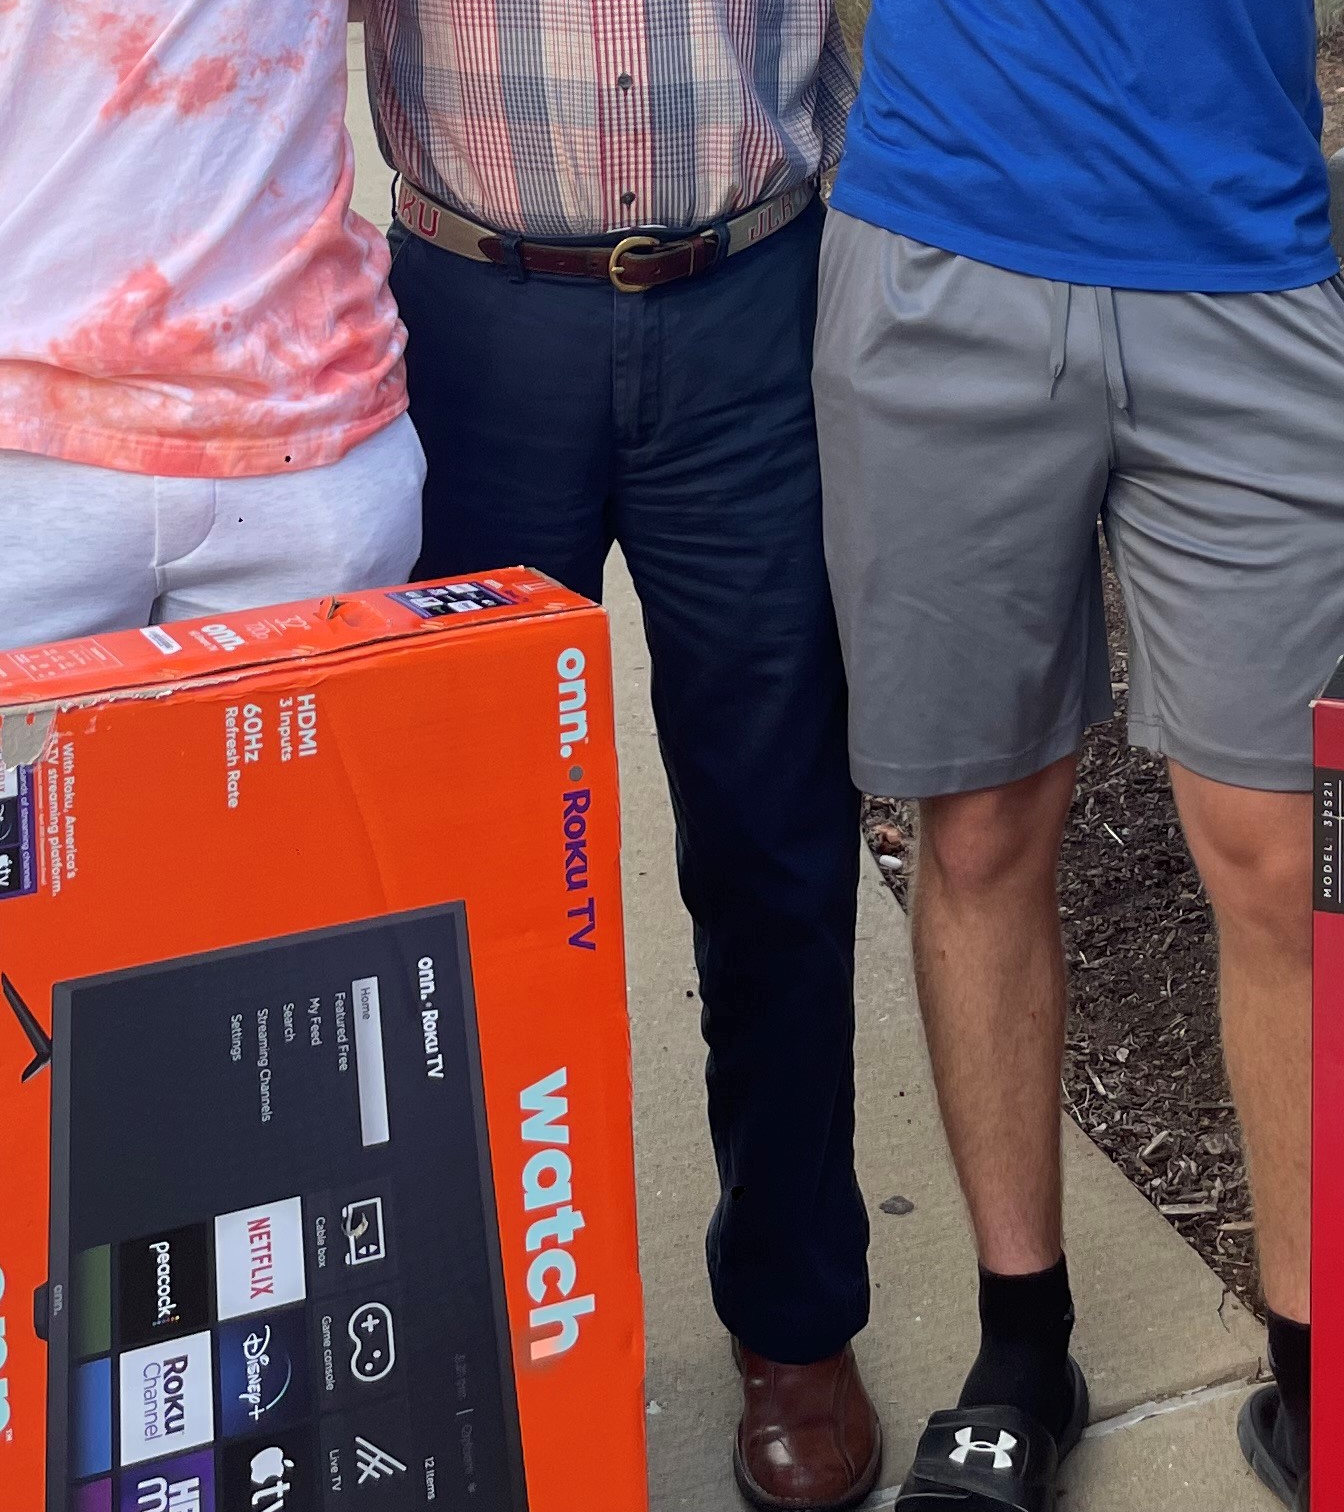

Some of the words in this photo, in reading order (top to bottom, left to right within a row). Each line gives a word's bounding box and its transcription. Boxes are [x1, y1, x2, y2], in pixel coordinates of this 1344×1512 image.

[278, 697, 292, 708] 3
[556, 646, 588, 759] onn.
[224, 706, 239, 767] Refresh
[242, 702, 264, 764] 60Hz
[279, 711, 293, 762] Inputs
[297, 693, 318, 758] HDMI
[47, 746, 60, 765] TV
[62, 742, 75, 776] With
[46, 770, 59, 834] streaming
[63, 777, 76, 814] Roku,
[227, 769, 241, 809] Rate
[1322, 782, 1333, 828] 32S21
[21, 808, 31, 852] streaming
[64, 816, 77, 880] America's
[22, 852, 32, 890] channels
[47, 838, 61, 896] platform.
[567, 897, 597, 952] TV
[282, 1002, 296, 1044] Search
[307, 996, 321, 1016] My
[334, 991, 348, 1044] Featured
[359, 987, 371, 1021] Home
[416, 955, 436, 1001] onn.
[427, 1054, 445, 1079] TV
[230, 1013, 243, 1062] Settings
[257, 1008, 269, 1068] Streaming
[310, 1017, 323, 1047] Feed
[338, 1044, 349, 1072] Free
[259, 1068, 272, 1123] Channels
[314, 1216, 326, 1245] Cable
[519, 1066, 596, 1361] watch
[246, 1216, 274, 1300] NETFLIX
[317, 1245, 327, 1268] box
[148, 1240, 176, 1322] peacock
[321, 1314, 333, 1350] Game
[323, 1350, 336, 1392] console
[142, 1361, 161, 1442] Channel
[328, 1448, 341, 1473] Live
[331, 1473, 343, 1492] TV
[424, 1455, 434, 1468] 12
[425, 1469, 436, 1501] Items
